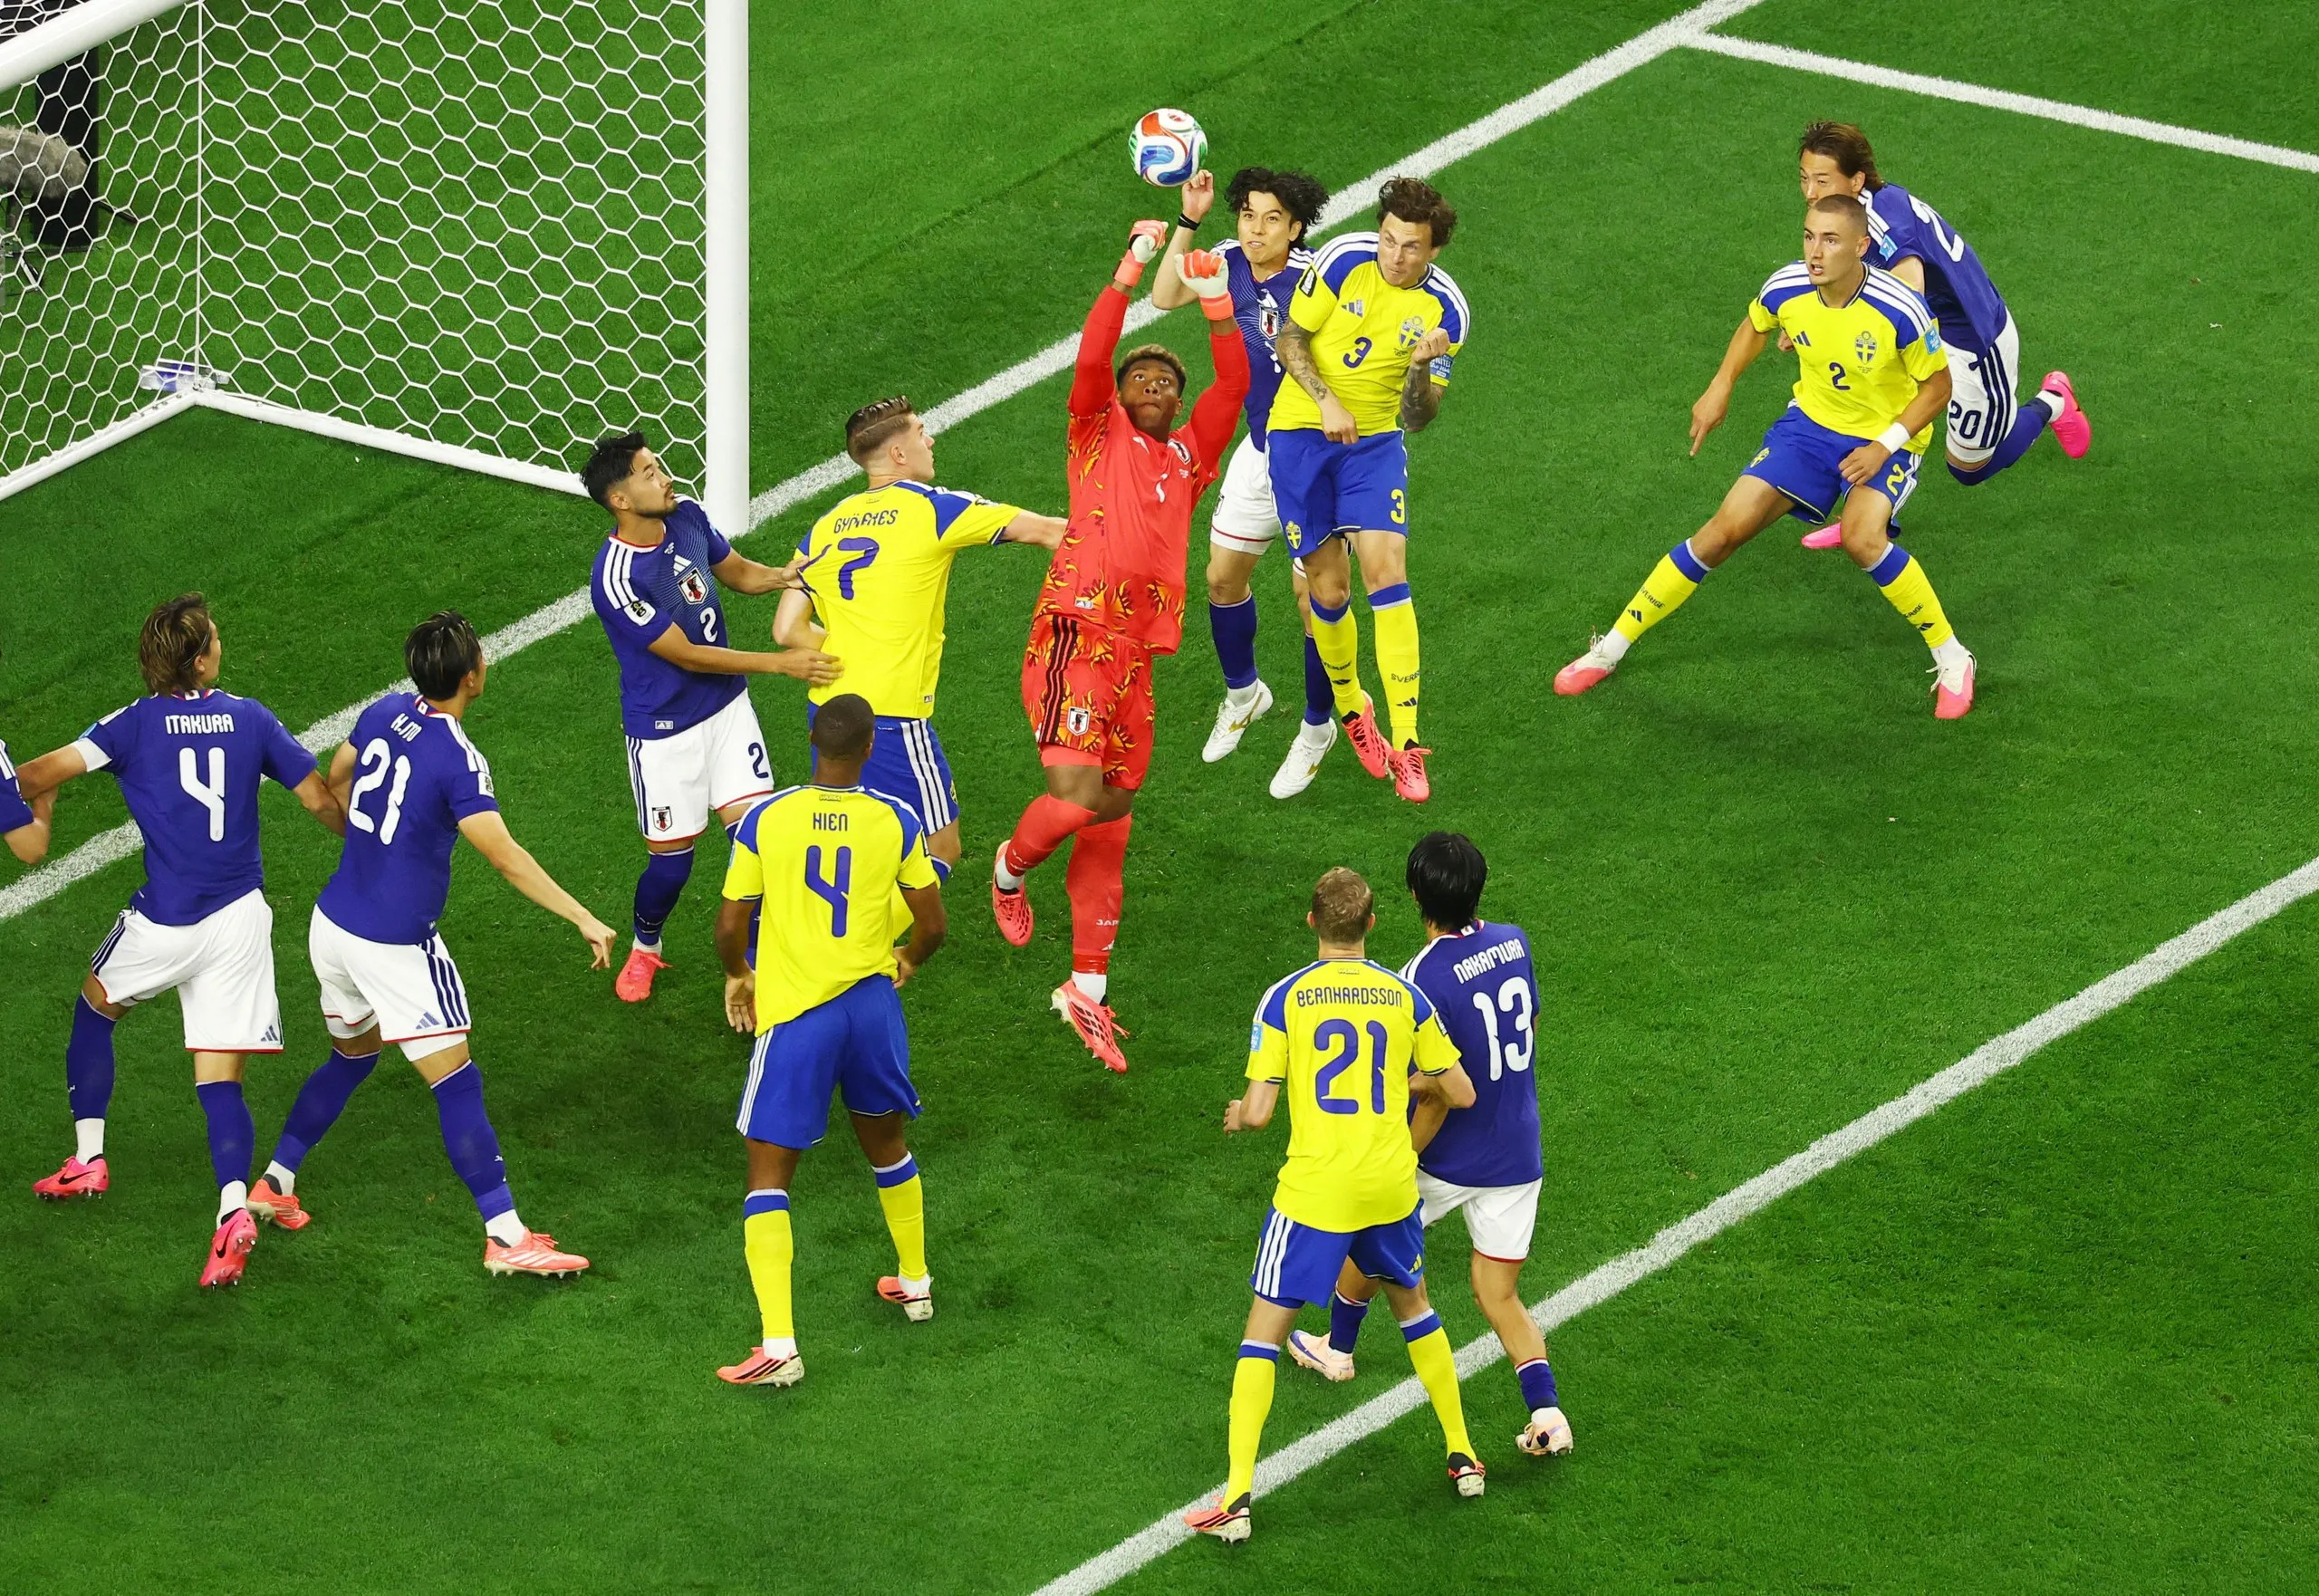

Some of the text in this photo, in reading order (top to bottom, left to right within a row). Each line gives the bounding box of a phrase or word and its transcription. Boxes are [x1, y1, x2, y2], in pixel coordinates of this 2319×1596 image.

[1342, 336, 1372, 369] 3
[1829, 362, 1851, 390] 2
[1949, 399, 1981, 439] 20
[1887, 464, 1905, 496] 2
[1390, 488, 1405, 524] 3
[699, 607, 718, 643] 2
[165, 714, 235, 735] ITAKURA
[390, 713, 422, 742] H.ITO
[747, 742, 769, 779] 2
[178, 746, 226, 842] 4
[348, 737, 412, 846] 21
[813, 812, 849, 832] HIEN
[804, 844, 852, 938] 4
[1452, 937, 1525, 985] NAKAMURA
[1296, 986, 1402, 1008] BERNHARDSSON
[1472, 976, 1534, 1082] 13
[1313, 1018, 1388, 1115] 21
